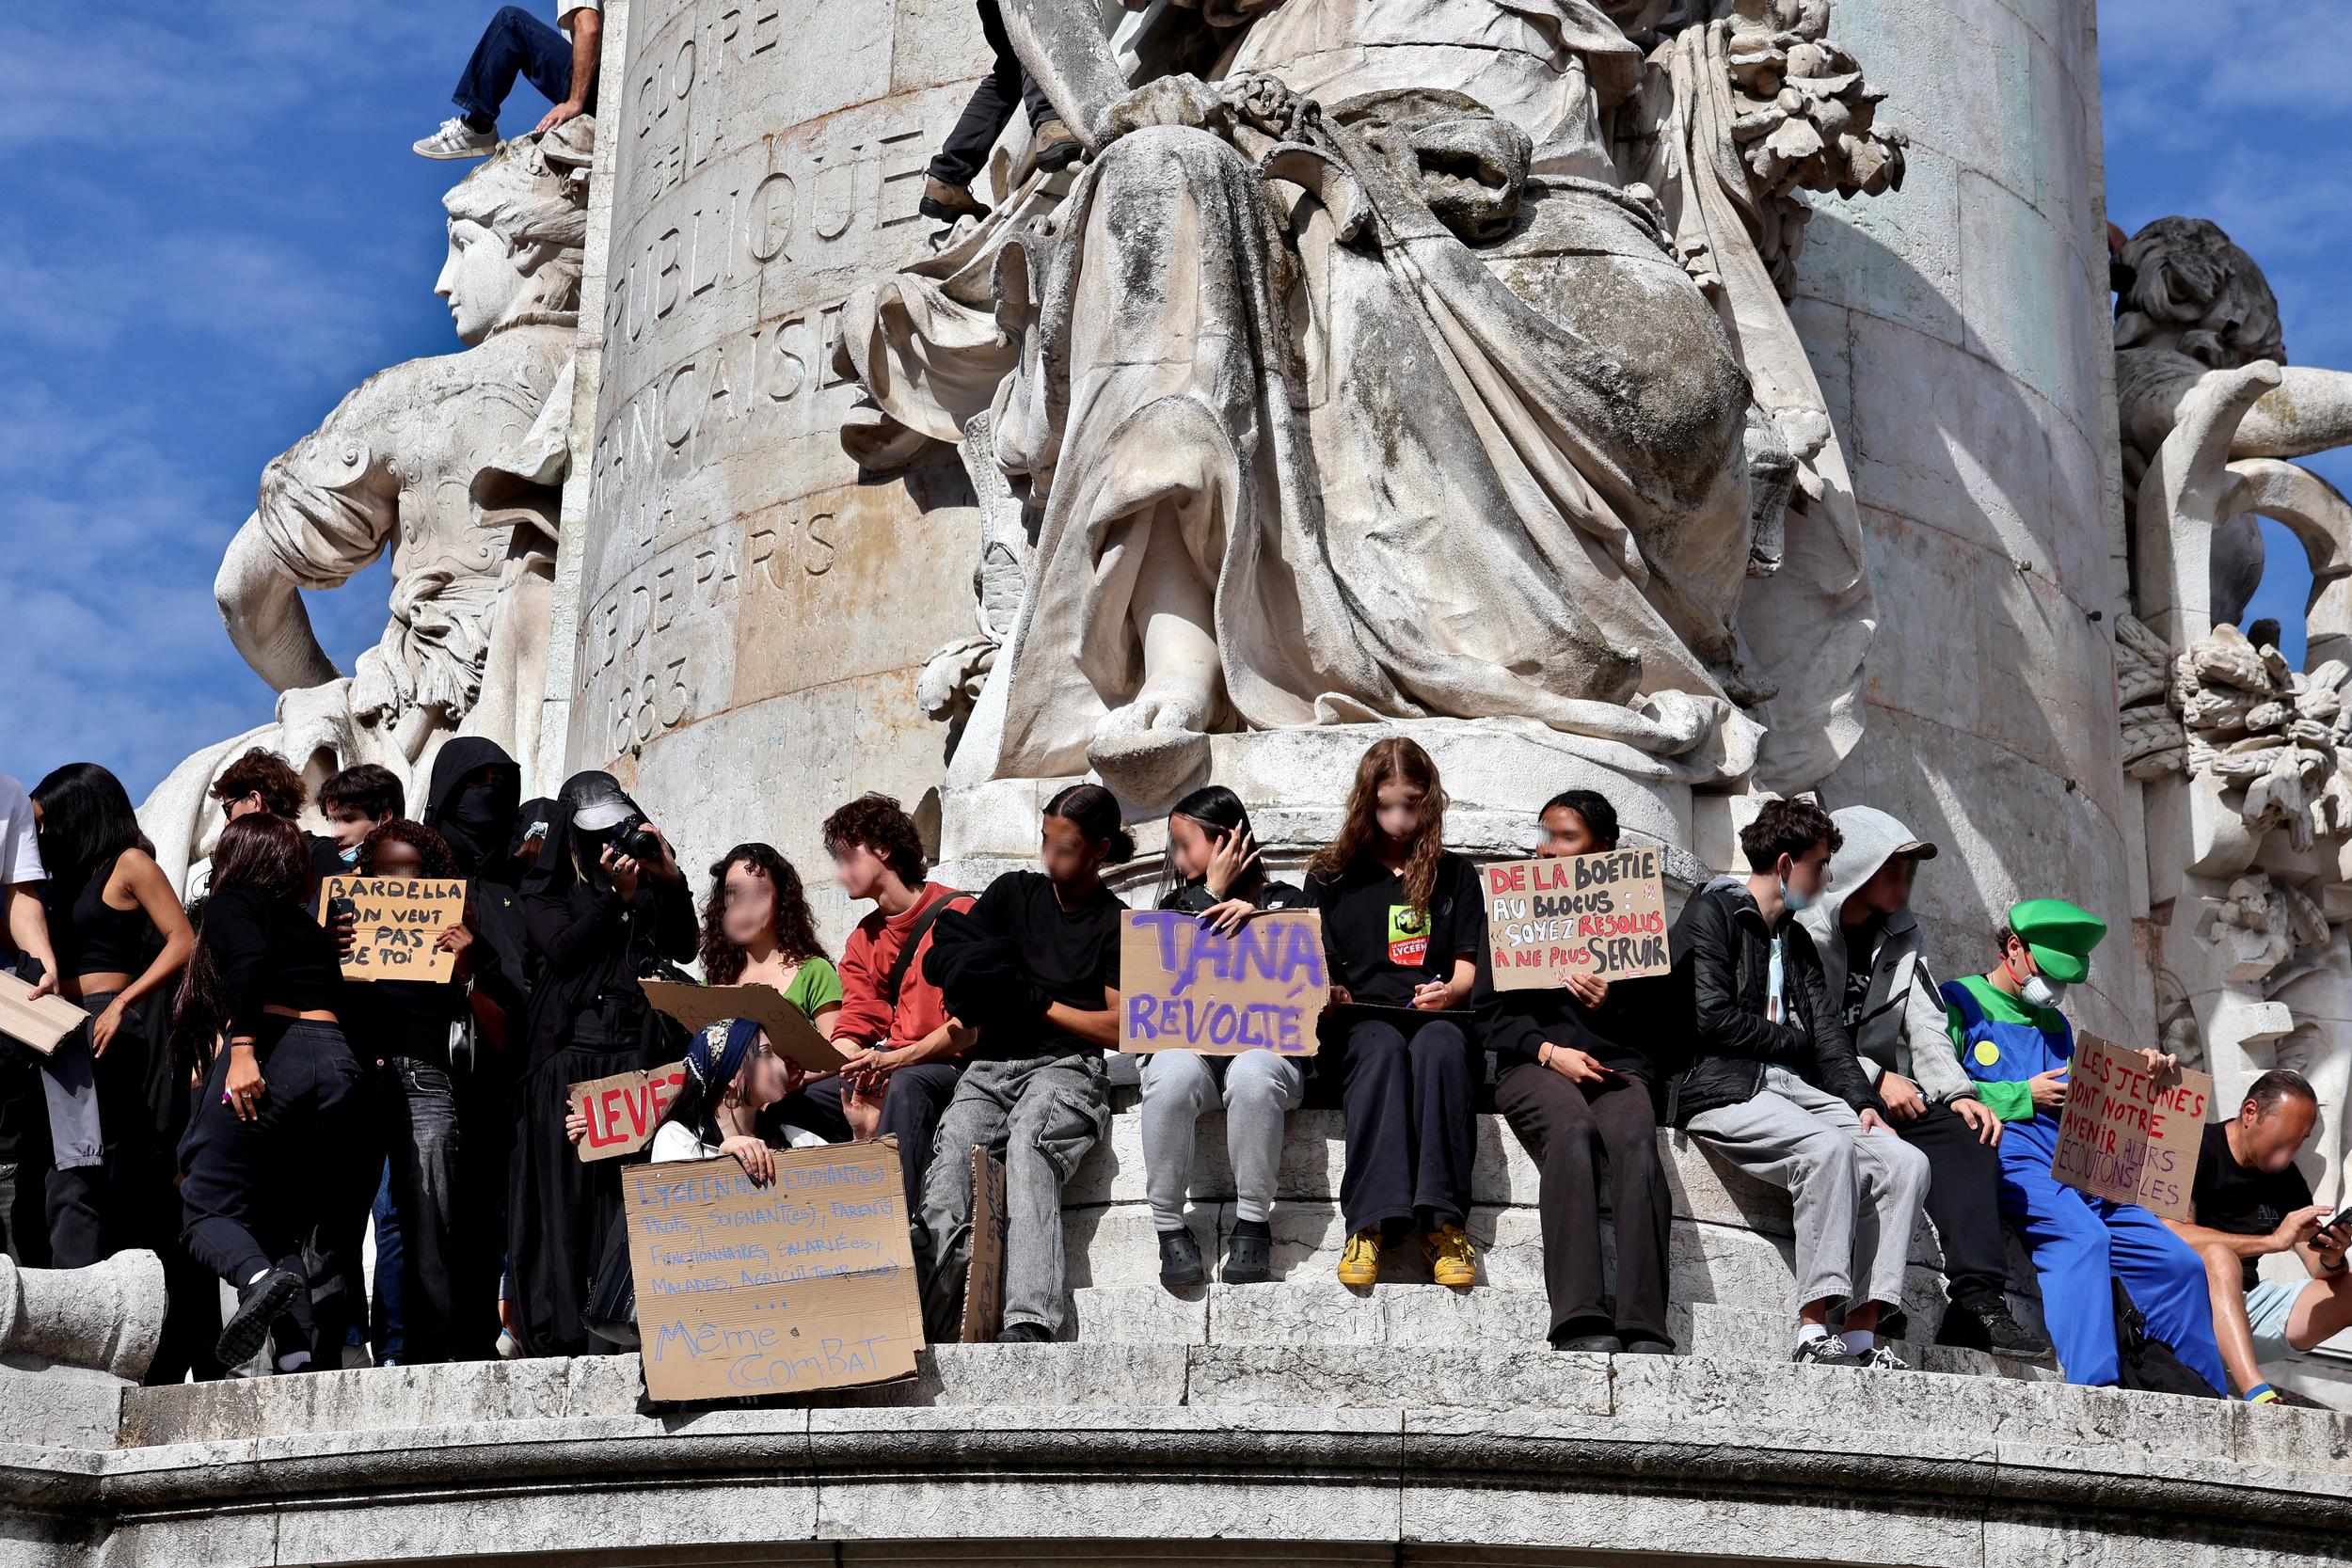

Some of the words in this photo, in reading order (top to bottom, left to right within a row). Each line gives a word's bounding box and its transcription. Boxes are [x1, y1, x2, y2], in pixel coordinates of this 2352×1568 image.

[637, 0, 779, 139] GLOIRE
[691, 513, 835, 616] PARIS
[603, 657, 688, 761] 1883
[329, 879, 462, 900] BARDELLA
[1489, 865, 1526, 895] DE
[1533, 863, 1568, 891] LA
[391, 909, 443, 925] VEUT
[1493, 898, 1526, 922] AU
[1534, 891, 1614, 918] BLOCUS
[374, 926, 424, 948] PAS
[1130, 911, 1325, 997] TANA
[1516, 950, 1541, 968] NE
[1549, 946, 1591, 968] PLUS
[1587, 935, 1667, 974] SERVIR
[2081, 1044, 2113, 1084] LES
[2115, 1067, 2205, 1117] JEUNES
[2068, 1075, 2101, 1112] SONT
[2101, 1095, 2168, 1140] NOTRE
[2123, 1139, 2177, 1173] ALORS
[655, 1320, 780, 1362] Même
